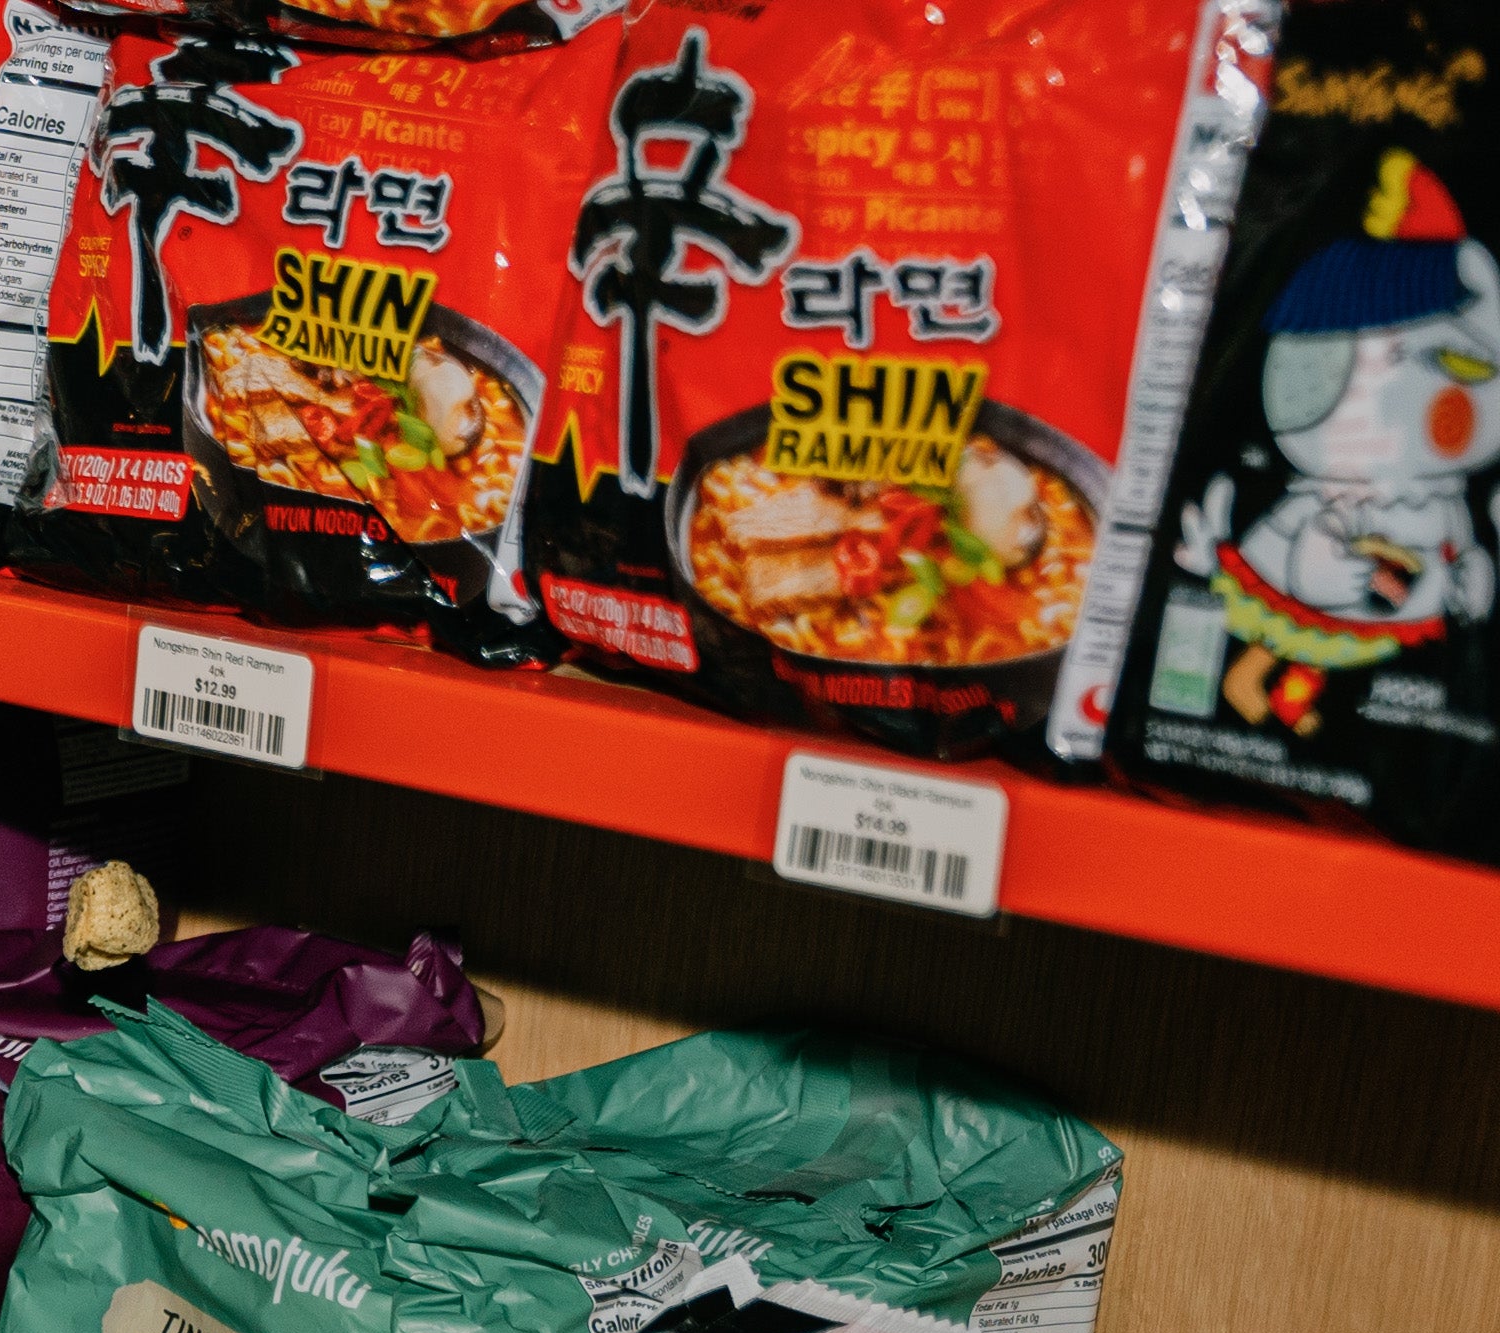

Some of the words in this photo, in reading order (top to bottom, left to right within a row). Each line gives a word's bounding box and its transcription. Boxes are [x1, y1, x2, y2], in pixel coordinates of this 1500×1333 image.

[359, 110, 465, 152] Picante
[283, 157, 452, 253] 라면
[274, 250, 435, 340] SHIN
[780, 246, 1002, 349] 라면
[260, 312, 407, 377] RAMYUN
[775, 356, 981, 432] SHIN
[72, 454, 115, 482] (120g)
[143, 460, 187, 485] BAGS
[769, 426, 952, 482] RAMYUN
[153, 636, 200, 657] Nongshim
[201, 647, 222, 662] Shin
[225, 651, 244, 666] Red
[247, 656, 285, 675] Ramyun
[194, 677, 238, 701] $12.99
[999, 1258, 1067, 1287] Calories
